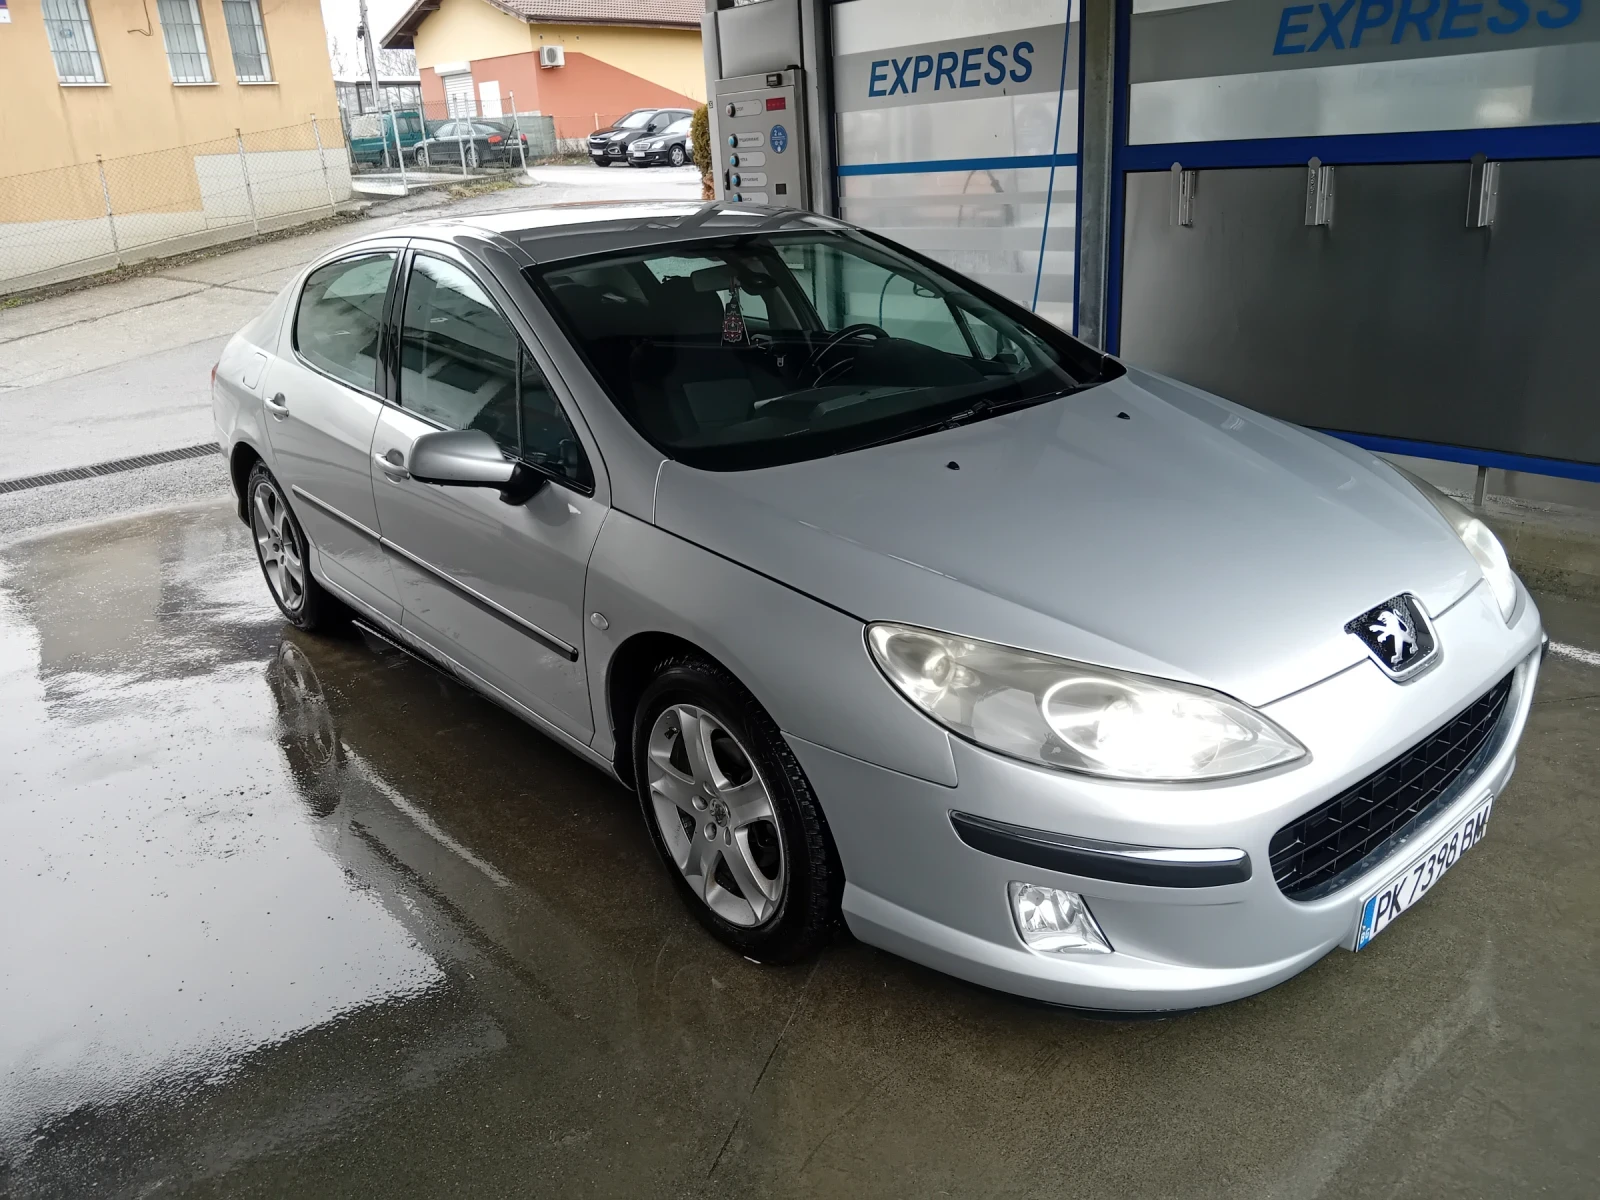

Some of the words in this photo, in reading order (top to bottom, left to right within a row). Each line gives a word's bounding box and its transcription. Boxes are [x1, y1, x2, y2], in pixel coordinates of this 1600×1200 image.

[1272, 0, 1582, 56] EXPRESS
[868, 41, 1035, 98] EXPRESS
[1373, 876, 1408, 933] PK
[1408, 832, 1459, 905] 7398
[1460, 805, 1489, 857] BM
